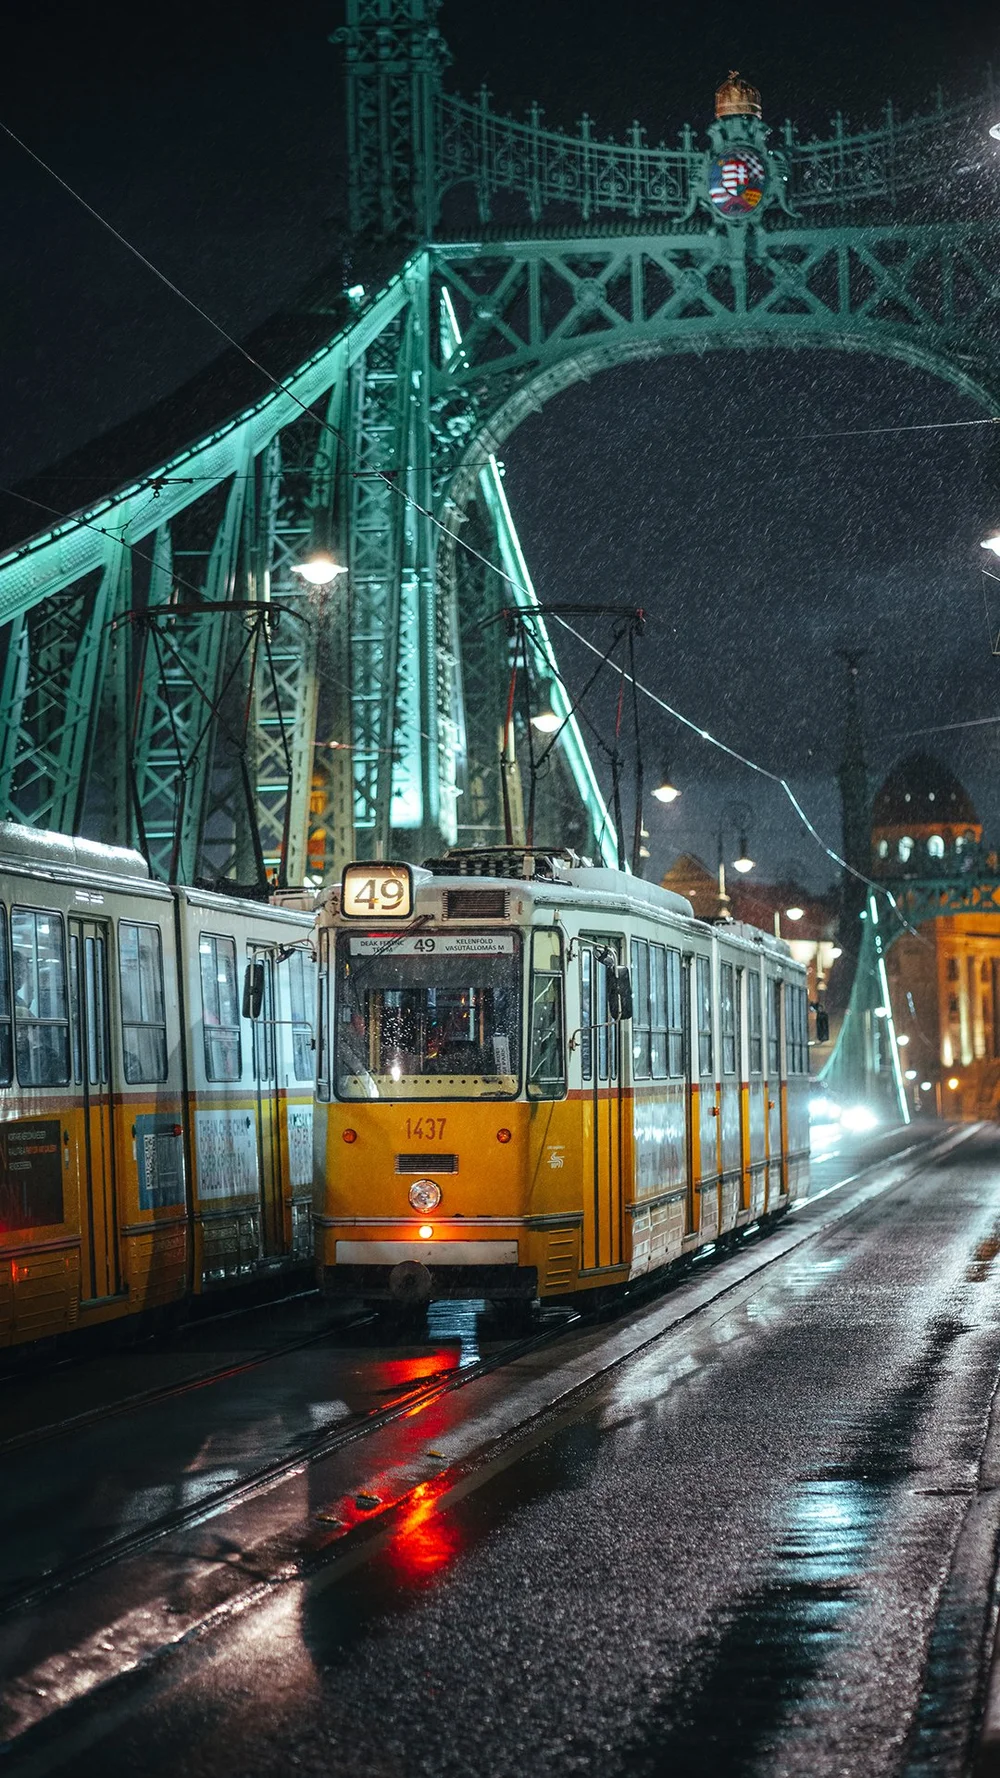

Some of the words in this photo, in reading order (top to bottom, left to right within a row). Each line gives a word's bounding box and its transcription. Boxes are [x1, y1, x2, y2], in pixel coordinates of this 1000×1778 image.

[354, 879, 404, 910] 49
[413, 938, 435, 953] 49
[406, 1117, 447, 1140] 1437
